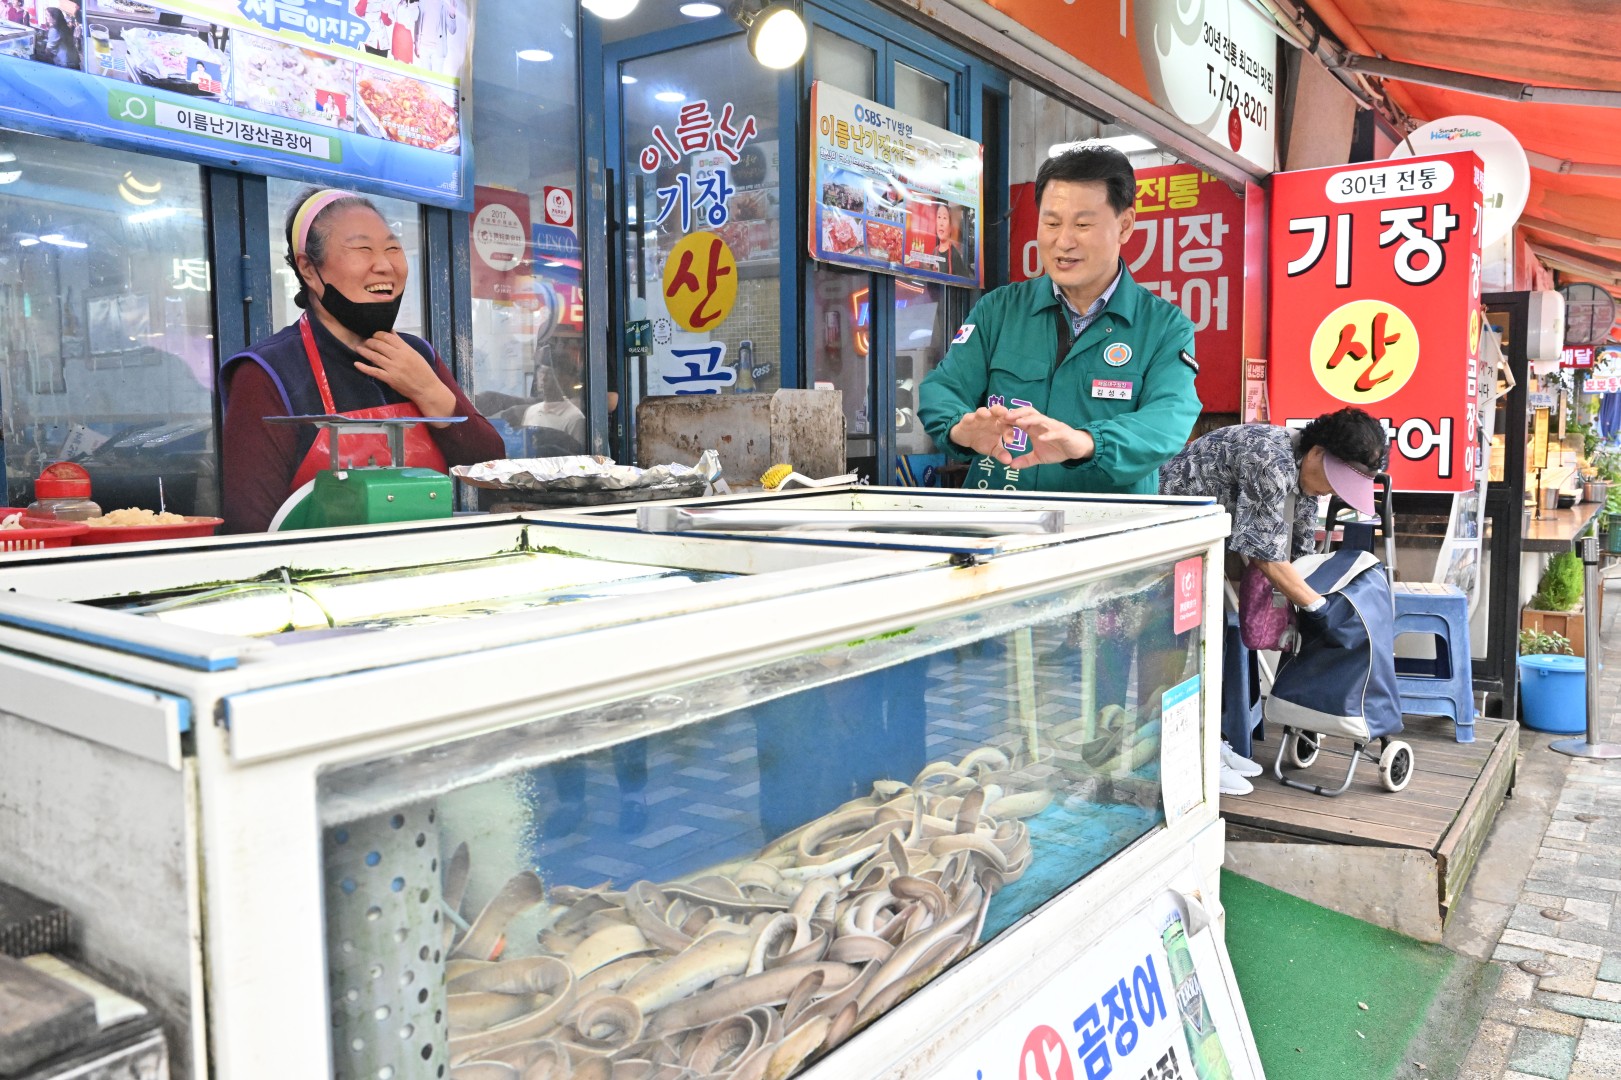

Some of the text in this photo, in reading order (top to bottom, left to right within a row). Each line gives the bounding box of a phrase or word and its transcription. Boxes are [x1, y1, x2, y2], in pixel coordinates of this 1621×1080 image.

[1203, 21, 1274, 95] 30년 전통 최고의 맛집
[177, 110, 313, 153] 이름난기장산곰장어
[641, 101, 755, 171] 이름난
[656, 170, 734, 231] 기장
[1341, 167, 1438, 196] 30년 전통
[491, 209, 507, 220] 2017
[1129, 213, 1229, 274] 기장
[666, 238, 731, 327] 산
[752, 364, 771, 379] Cass
[1326, 311, 1401, 392] 산
[1073, 953, 1168, 1080] 곰장어
